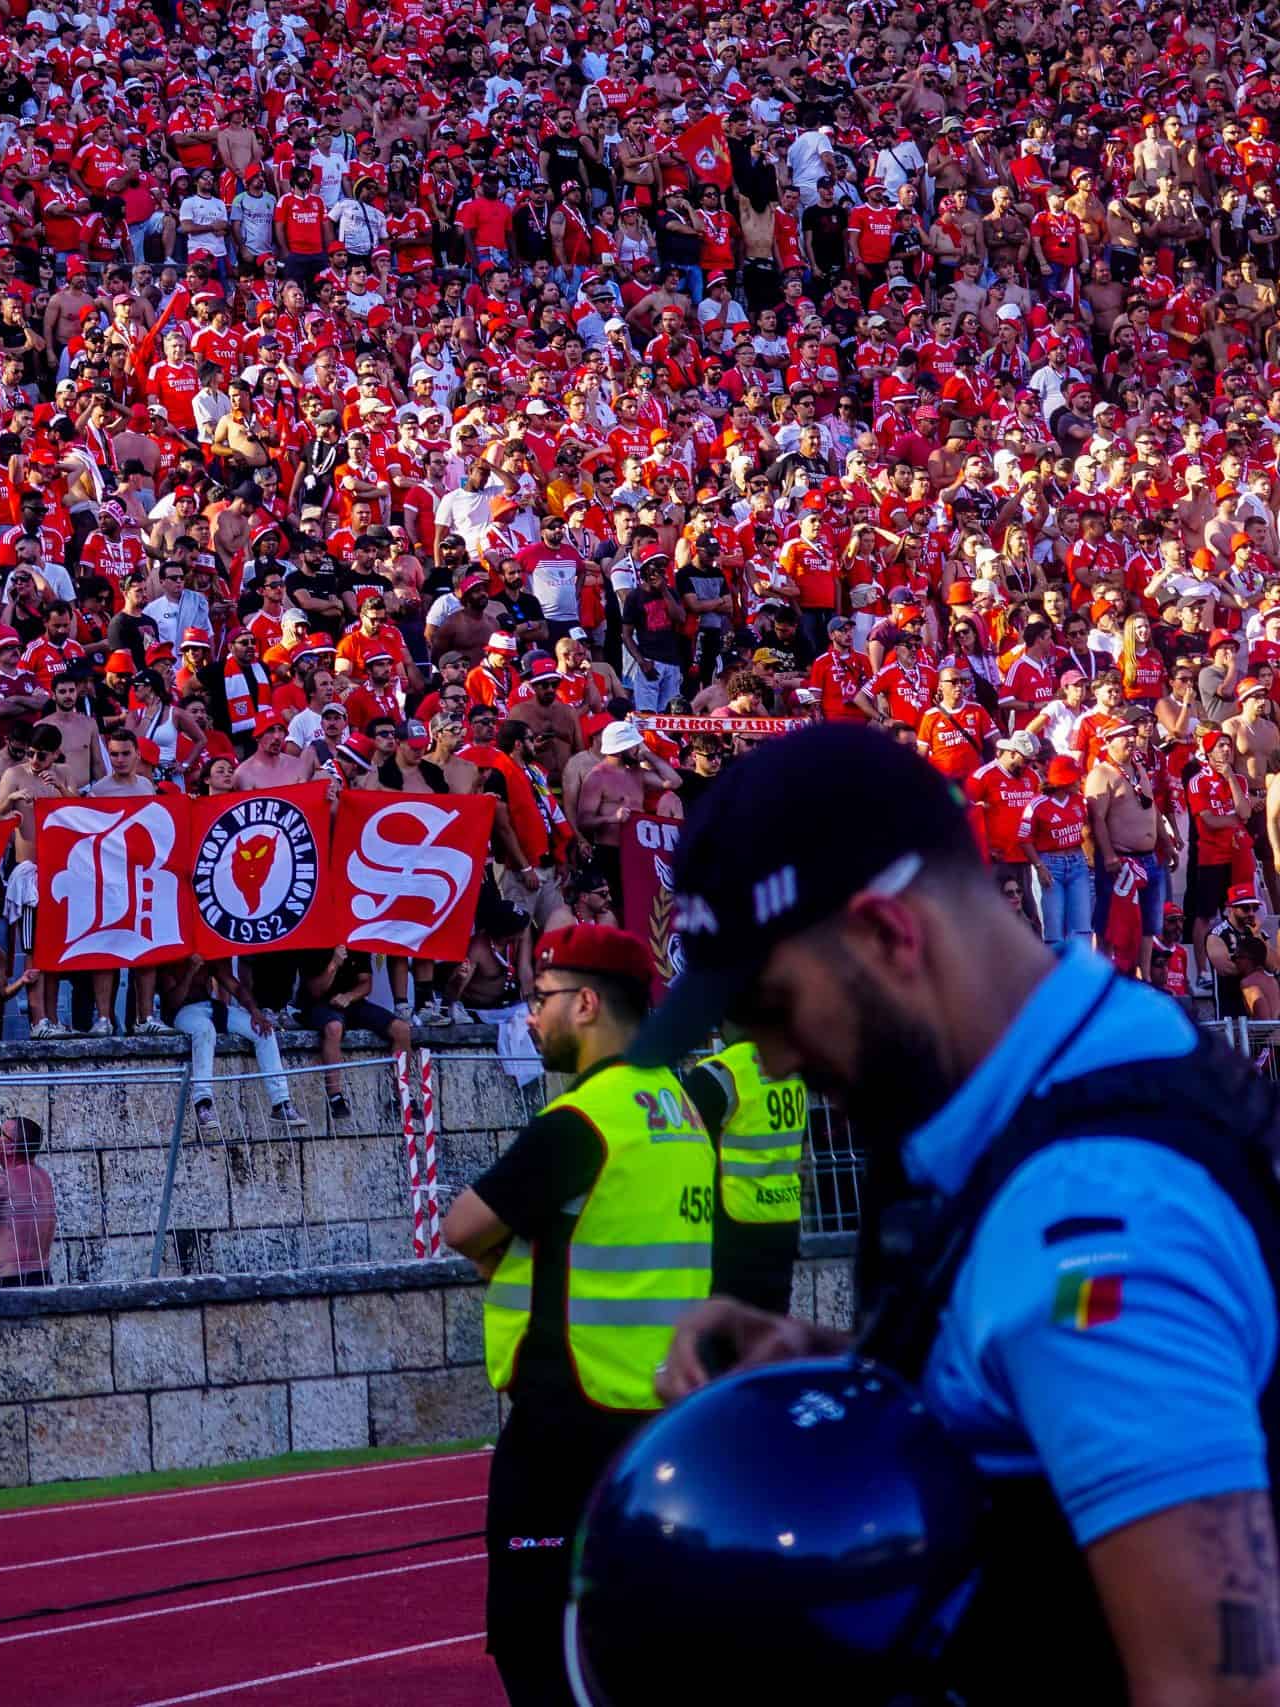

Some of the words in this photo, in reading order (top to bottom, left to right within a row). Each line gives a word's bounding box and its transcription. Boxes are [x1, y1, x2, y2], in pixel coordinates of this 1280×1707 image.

[656, 716, 724, 732] DIABOS
[731, 718, 786, 734] PARIS
[195, 823, 229, 928] DIABOS
[228, 915, 288, 942] 1982
